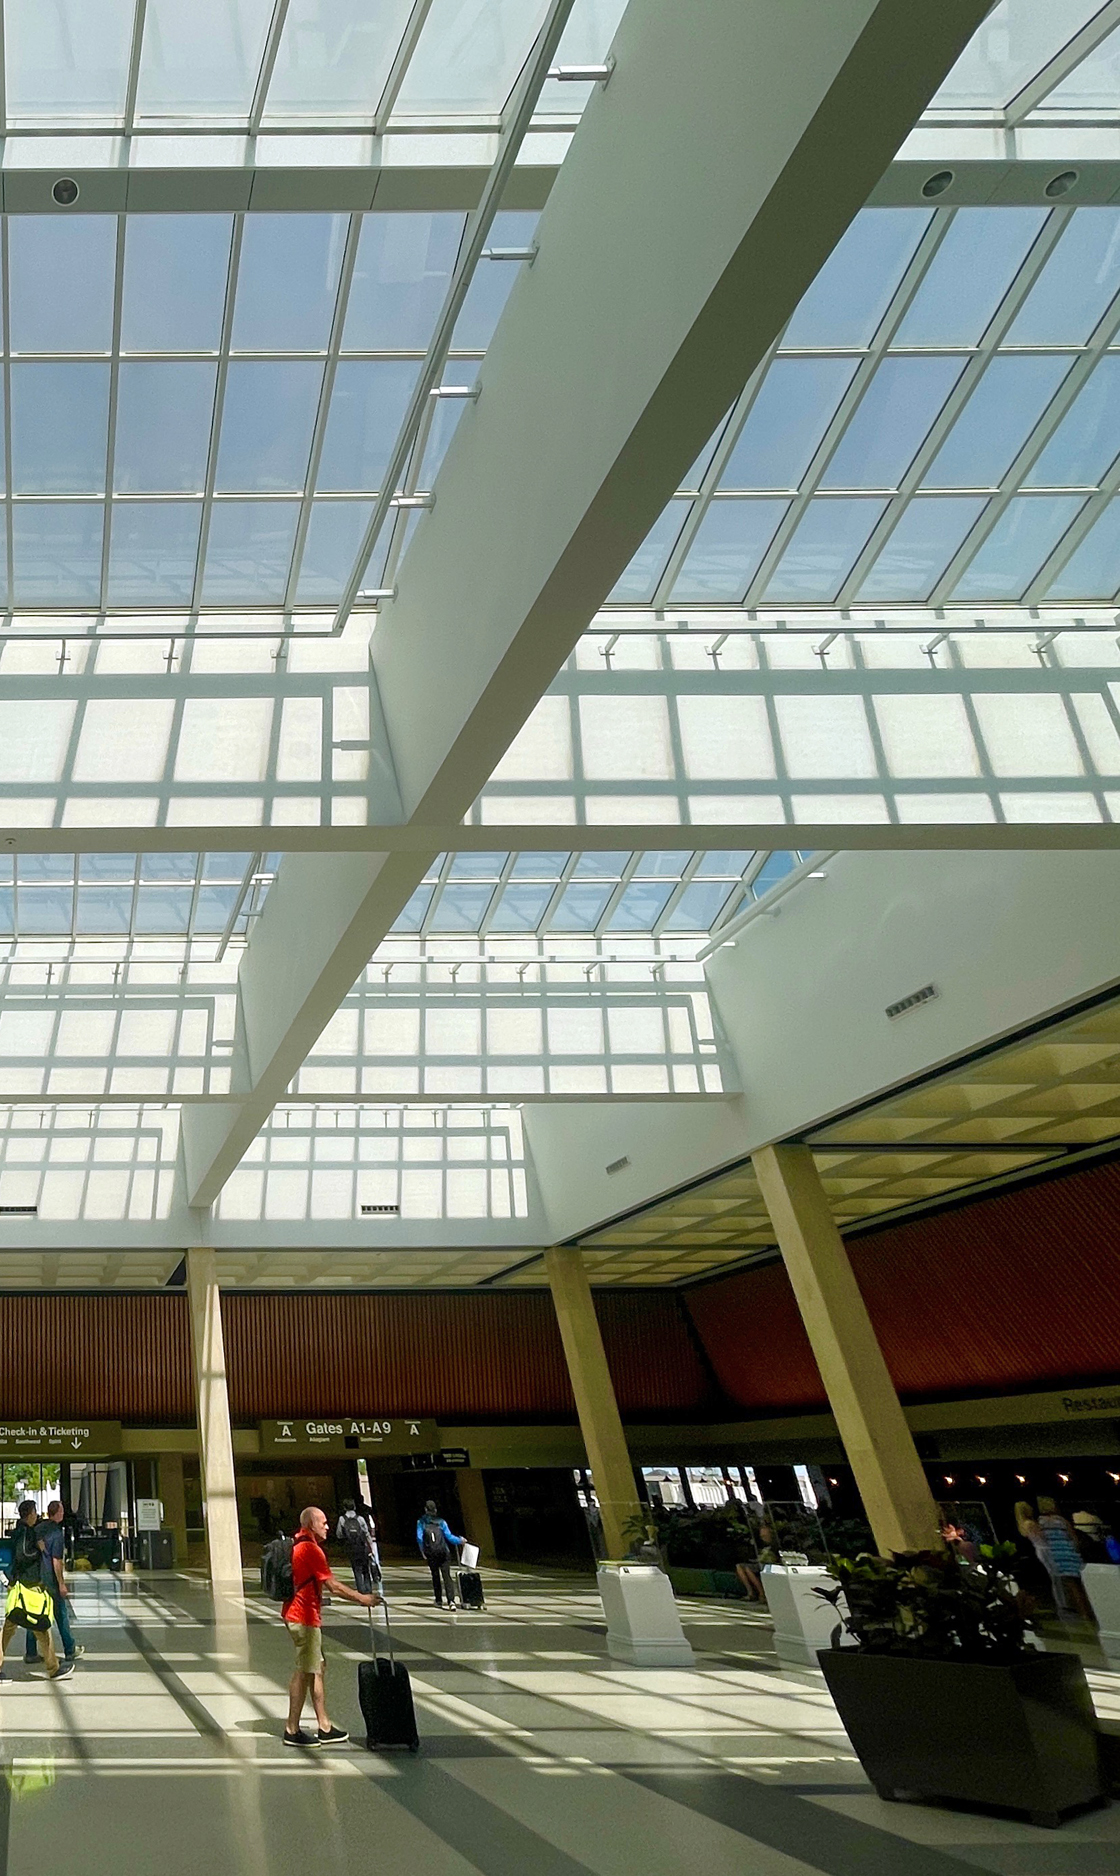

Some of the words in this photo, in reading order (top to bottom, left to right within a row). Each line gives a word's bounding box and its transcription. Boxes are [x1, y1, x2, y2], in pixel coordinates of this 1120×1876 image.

[39, 1427, 47, 1436] &
[48, 1427, 89, 1437] Ticketing
[282, 1426, 291, 1436] A
[305, 1422, 343, 1434] Gates
[350, 1421, 391, 1434] A1-A9
[410, 1425, 419, 1435] A
